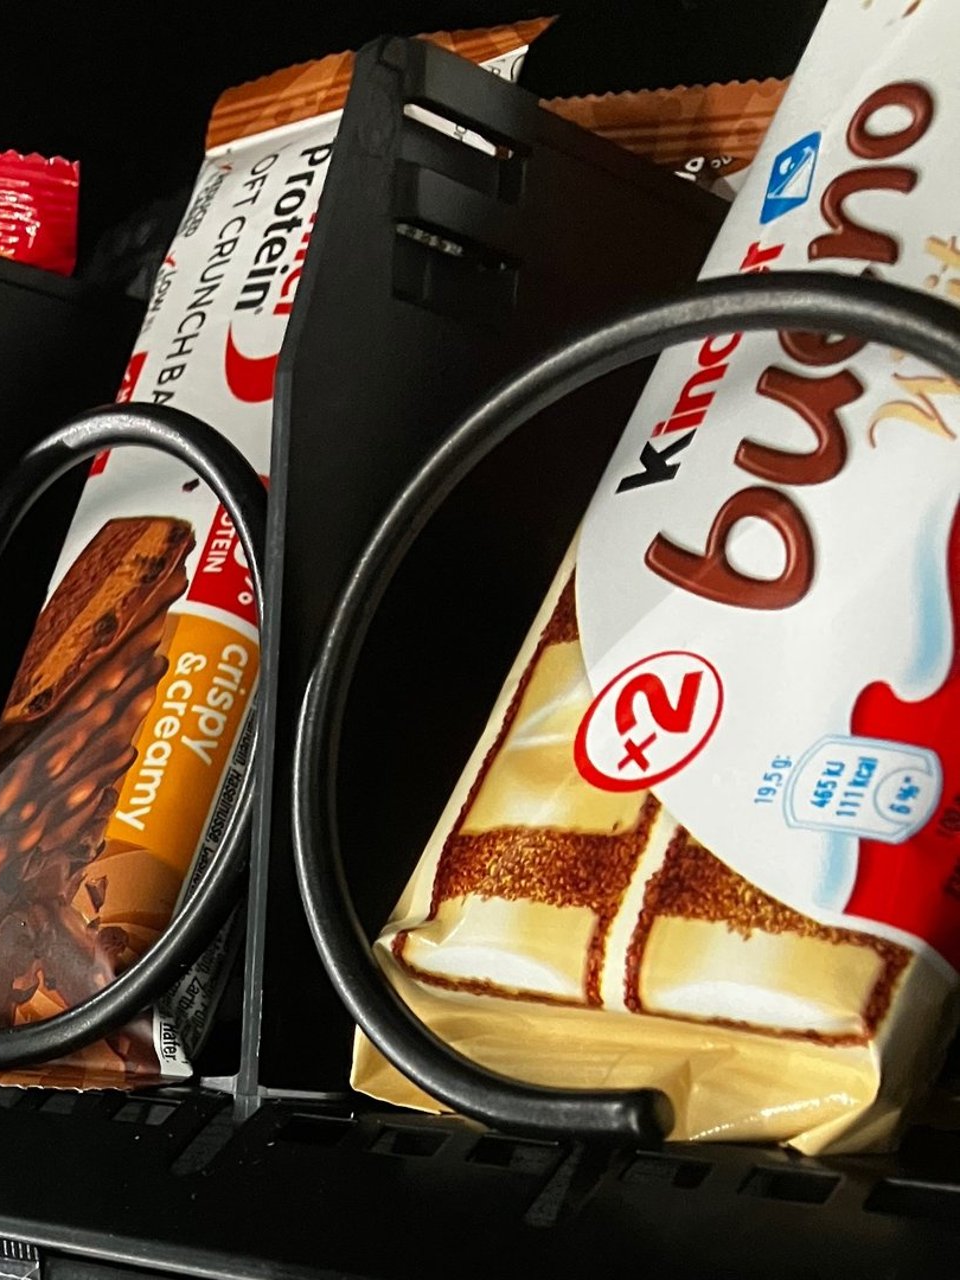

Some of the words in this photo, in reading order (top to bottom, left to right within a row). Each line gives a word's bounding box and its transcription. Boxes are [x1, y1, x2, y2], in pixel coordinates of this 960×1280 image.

[233, 150, 283, 208] OFT
[166, 215, 247, 361] CRUNCH
[151, 362, 187, 405] BA
[181, 643, 248, 766] crispy
[115, 679, 193, 831] creamy
[835, 791, 864, 817] 111
